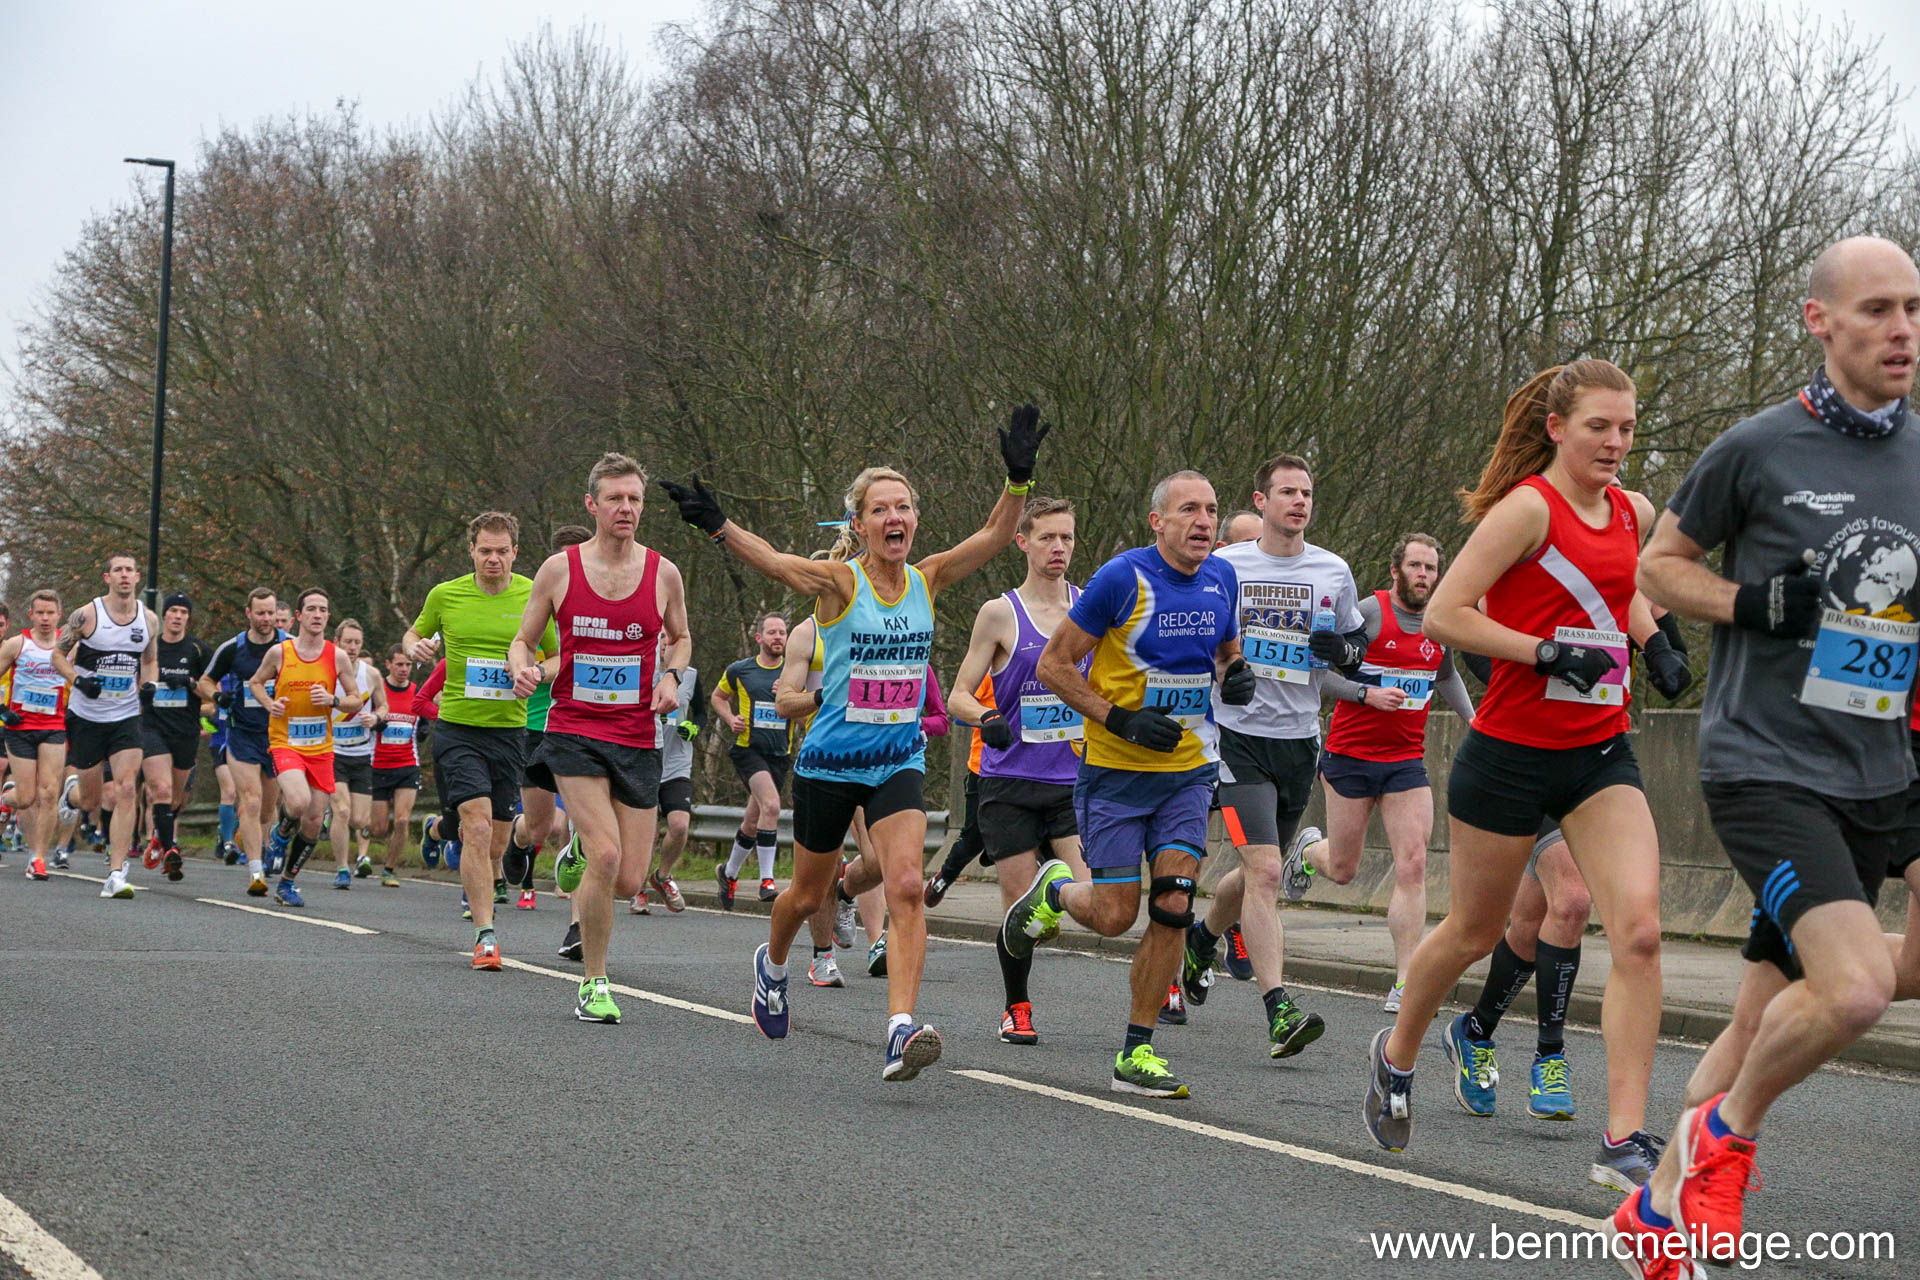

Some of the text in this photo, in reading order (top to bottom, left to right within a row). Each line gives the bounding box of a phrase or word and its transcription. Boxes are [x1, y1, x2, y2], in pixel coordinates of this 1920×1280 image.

[1815, 491, 1856, 504] yorkshire
[1807, 551, 1828, 577] The
[1824, 517, 1869, 549] world's
[1243, 585, 1310, 600] DRIFFIELD
[1251, 598, 1301, 608] TRIATHLON
[572, 615, 609, 629] RIPON
[883, 615, 910, 631] KAY
[1158, 610, 1216, 628] REDCAR
[1825, 611, 1867, 629] BRASS
[572, 626, 624, 641] RUNNERS
[850, 631, 887, 645] NEW
[1158, 626, 1216, 638] RUNNING CLUB
[1247, 627, 1269, 637] BRASS
[1270, 630, 1299, 641] MONKEY
[1557, 628, 1586, 639] BRASS
[575, 654, 596, 662] BRASS
[849, 645, 930, 662] HARRIERS
[1252, 640, 1305, 665] 1515
[1840, 638, 1912, 681] 282
[478, 668, 510, 685] 345
[588, 666, 627, 686] 276
[852, 667, 878, 676] BRASS
[879, 668, 907, 676] MONKEY
[1148, 675, 1171, 684] BRASS
[1172, 676, 1199, 684] MONKEY
[28, 691, 56, 705] 1267
[860, 681, 914, 703] 1172
[1154, 689, 1205, 710] 1052
[1035, 705, 1074, 725] 726
[294, 723, 323, 736] 1104
